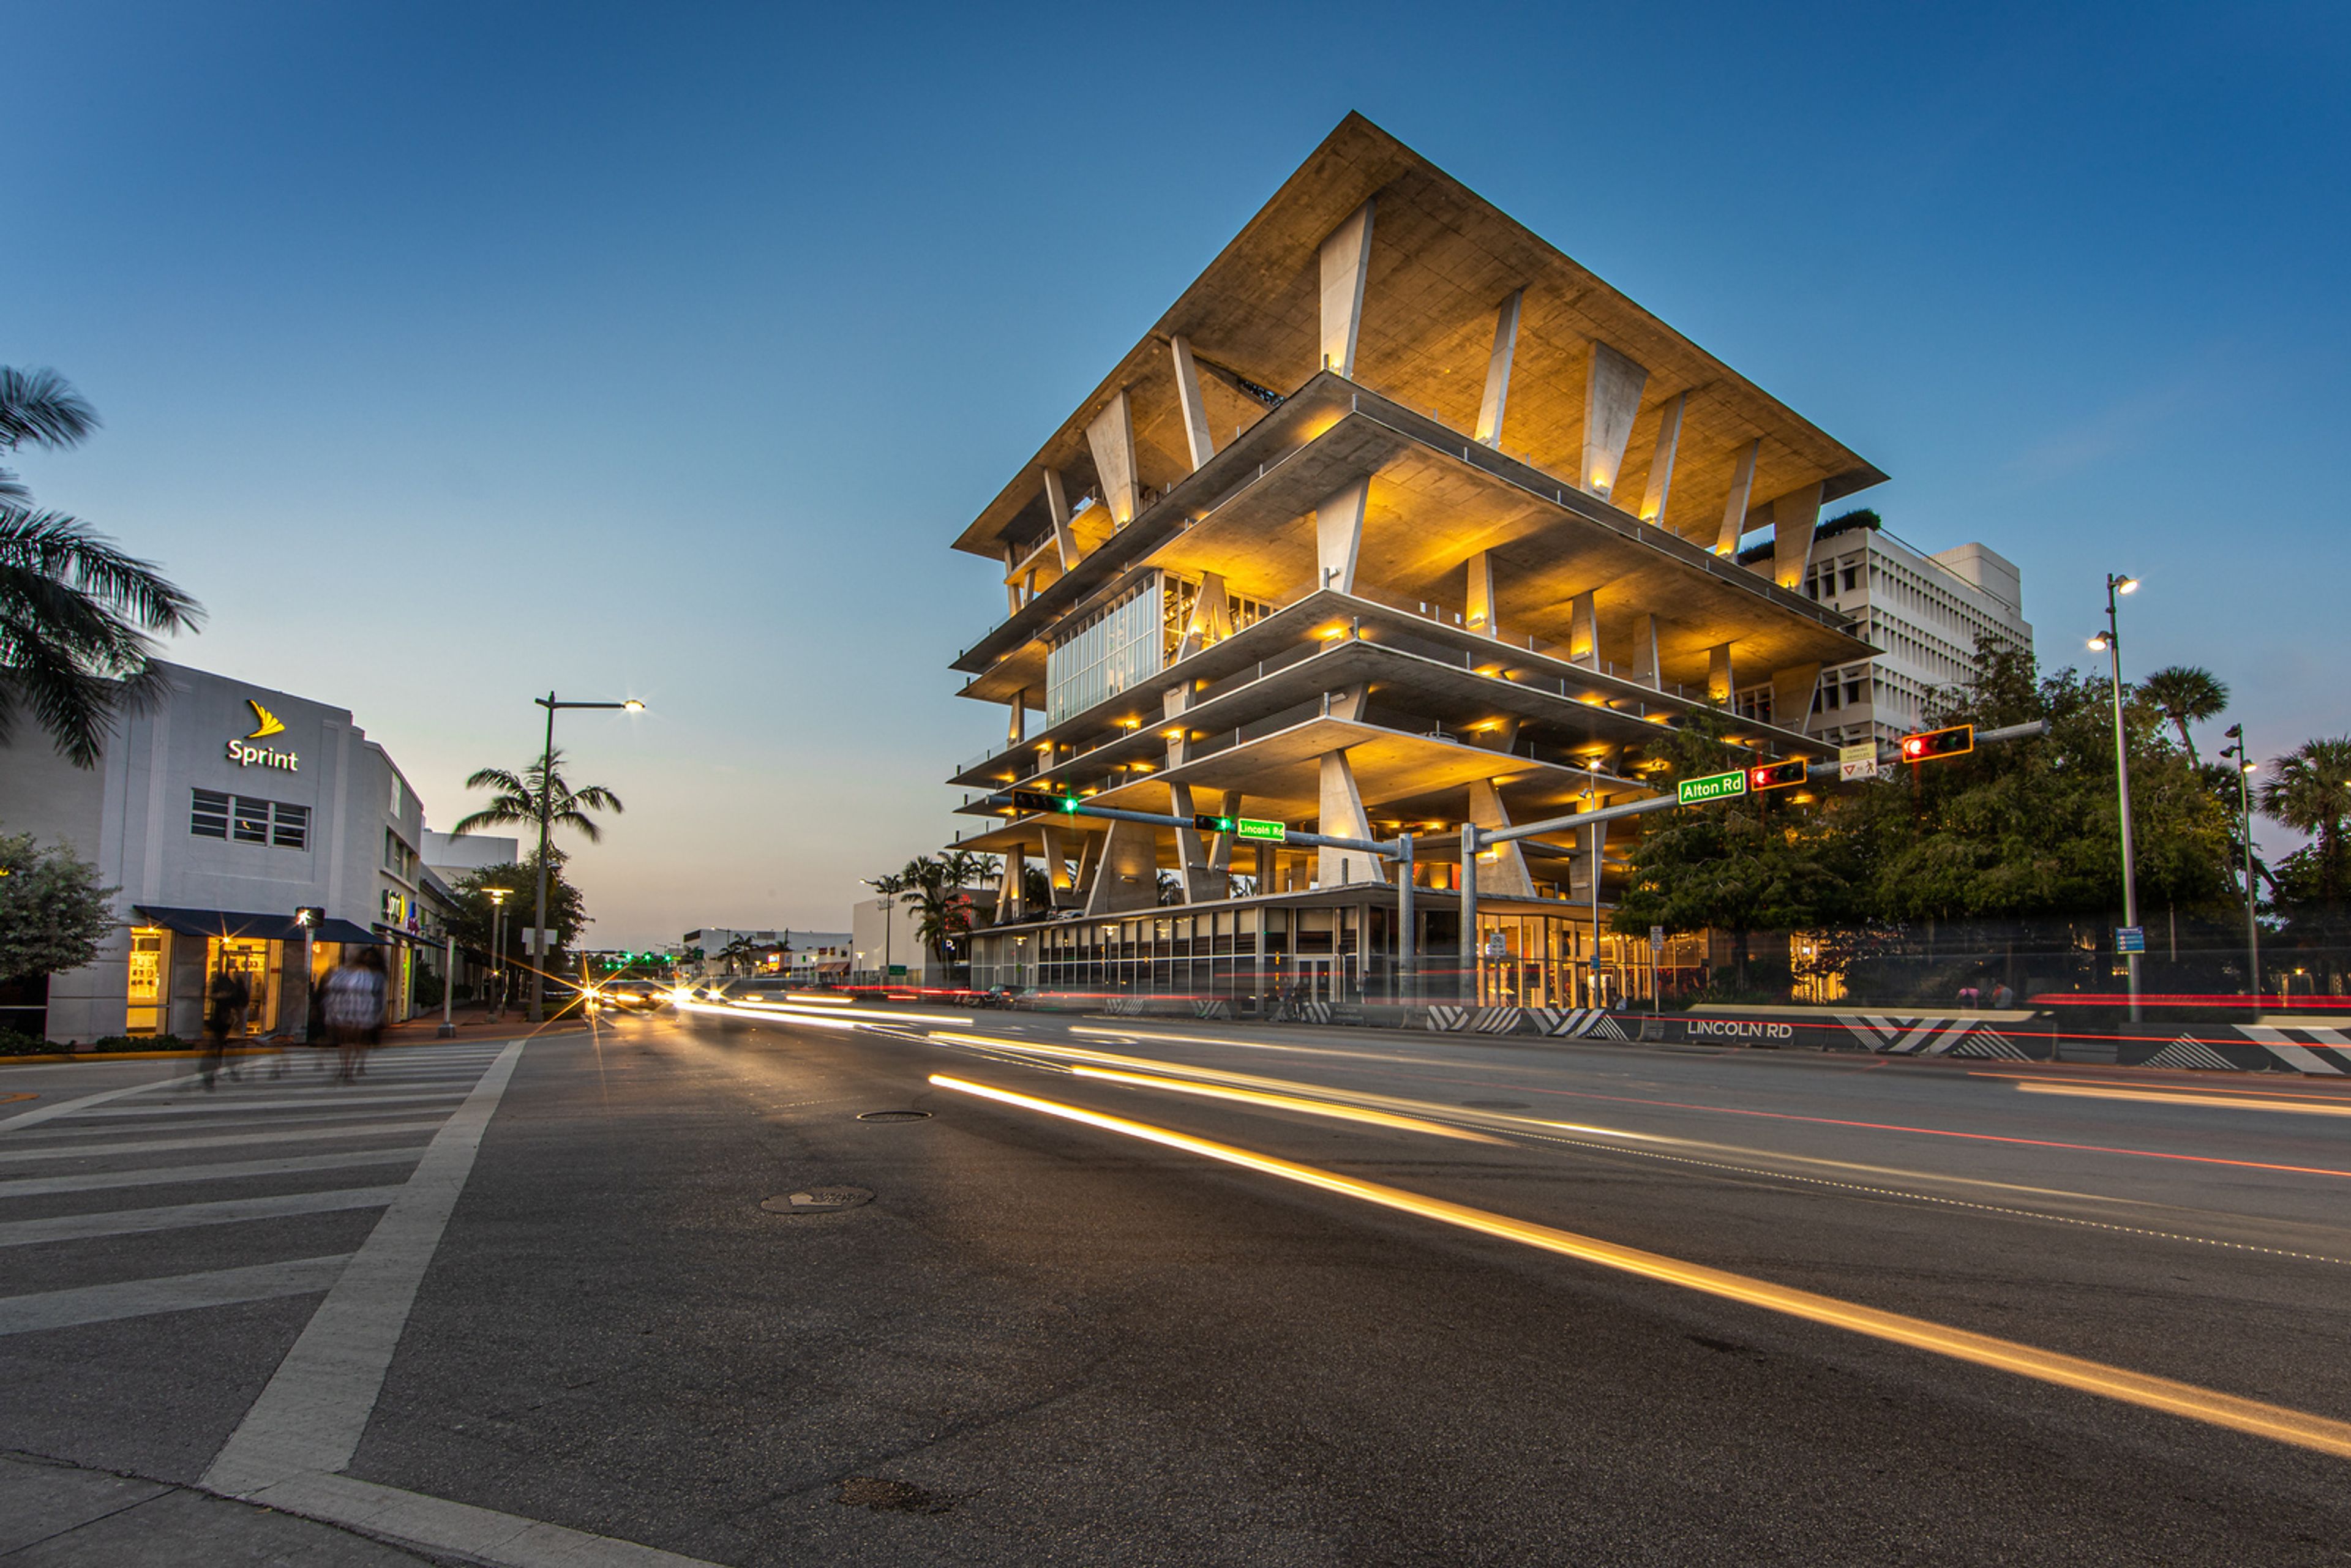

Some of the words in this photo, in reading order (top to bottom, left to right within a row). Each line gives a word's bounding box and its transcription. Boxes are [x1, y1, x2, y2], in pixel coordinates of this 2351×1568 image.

[228, 739, 299, 771] Sprint
[1684, 784, 1719, 798] Alton
[1723, 776, 1741, 792] Rd
[1240, 823, 1270, 835] Lincoln
[1273, 826, 1284, 837] Rd
[1688, 1021, 1762, 1037] LINCOLN
[1766, 1024, 1793, 1038] RD
